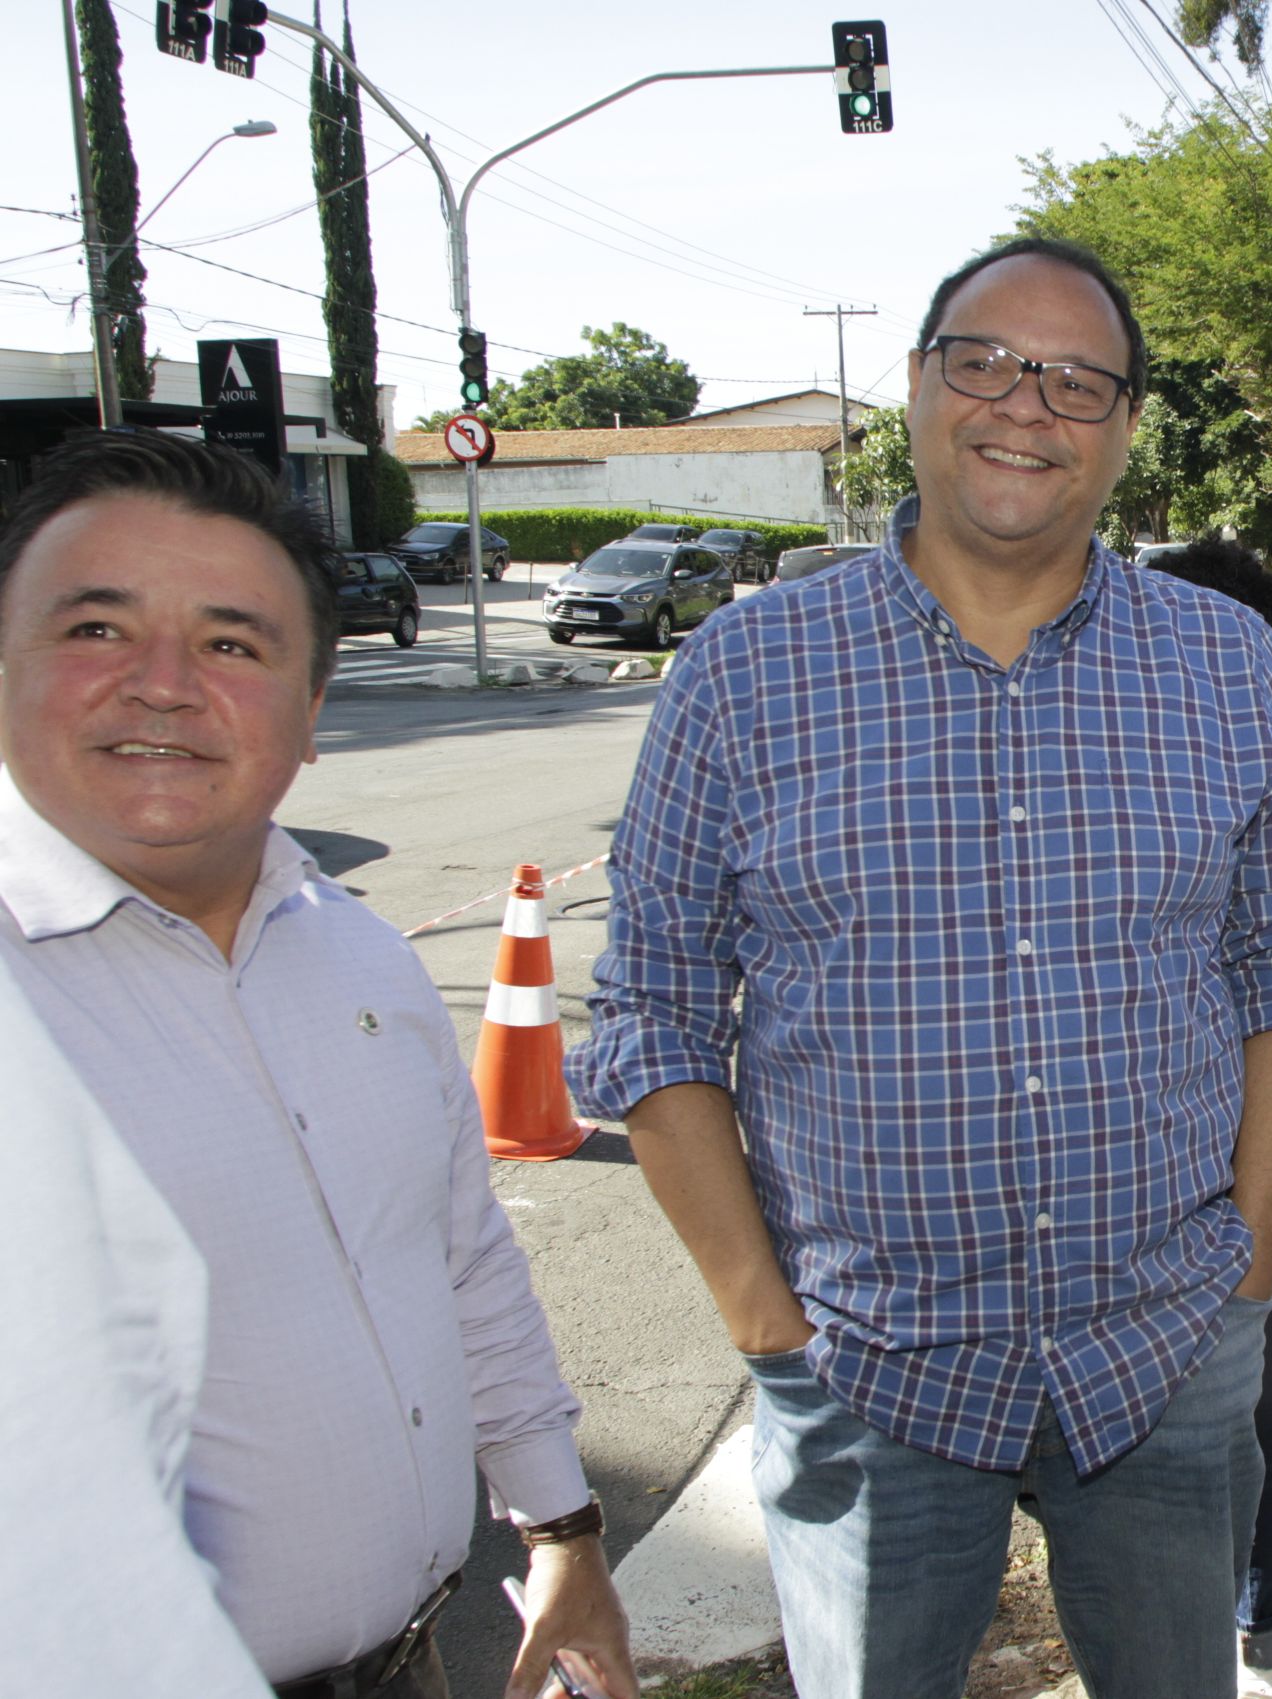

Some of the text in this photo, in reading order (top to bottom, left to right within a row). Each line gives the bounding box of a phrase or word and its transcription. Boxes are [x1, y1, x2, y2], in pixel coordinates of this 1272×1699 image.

[167, 40, 197, 61] 111A
[223, 58, 248, 78] 111A
[853, 120, 883, 133] 111C
[219, 390, 258, 403] AJOUR
